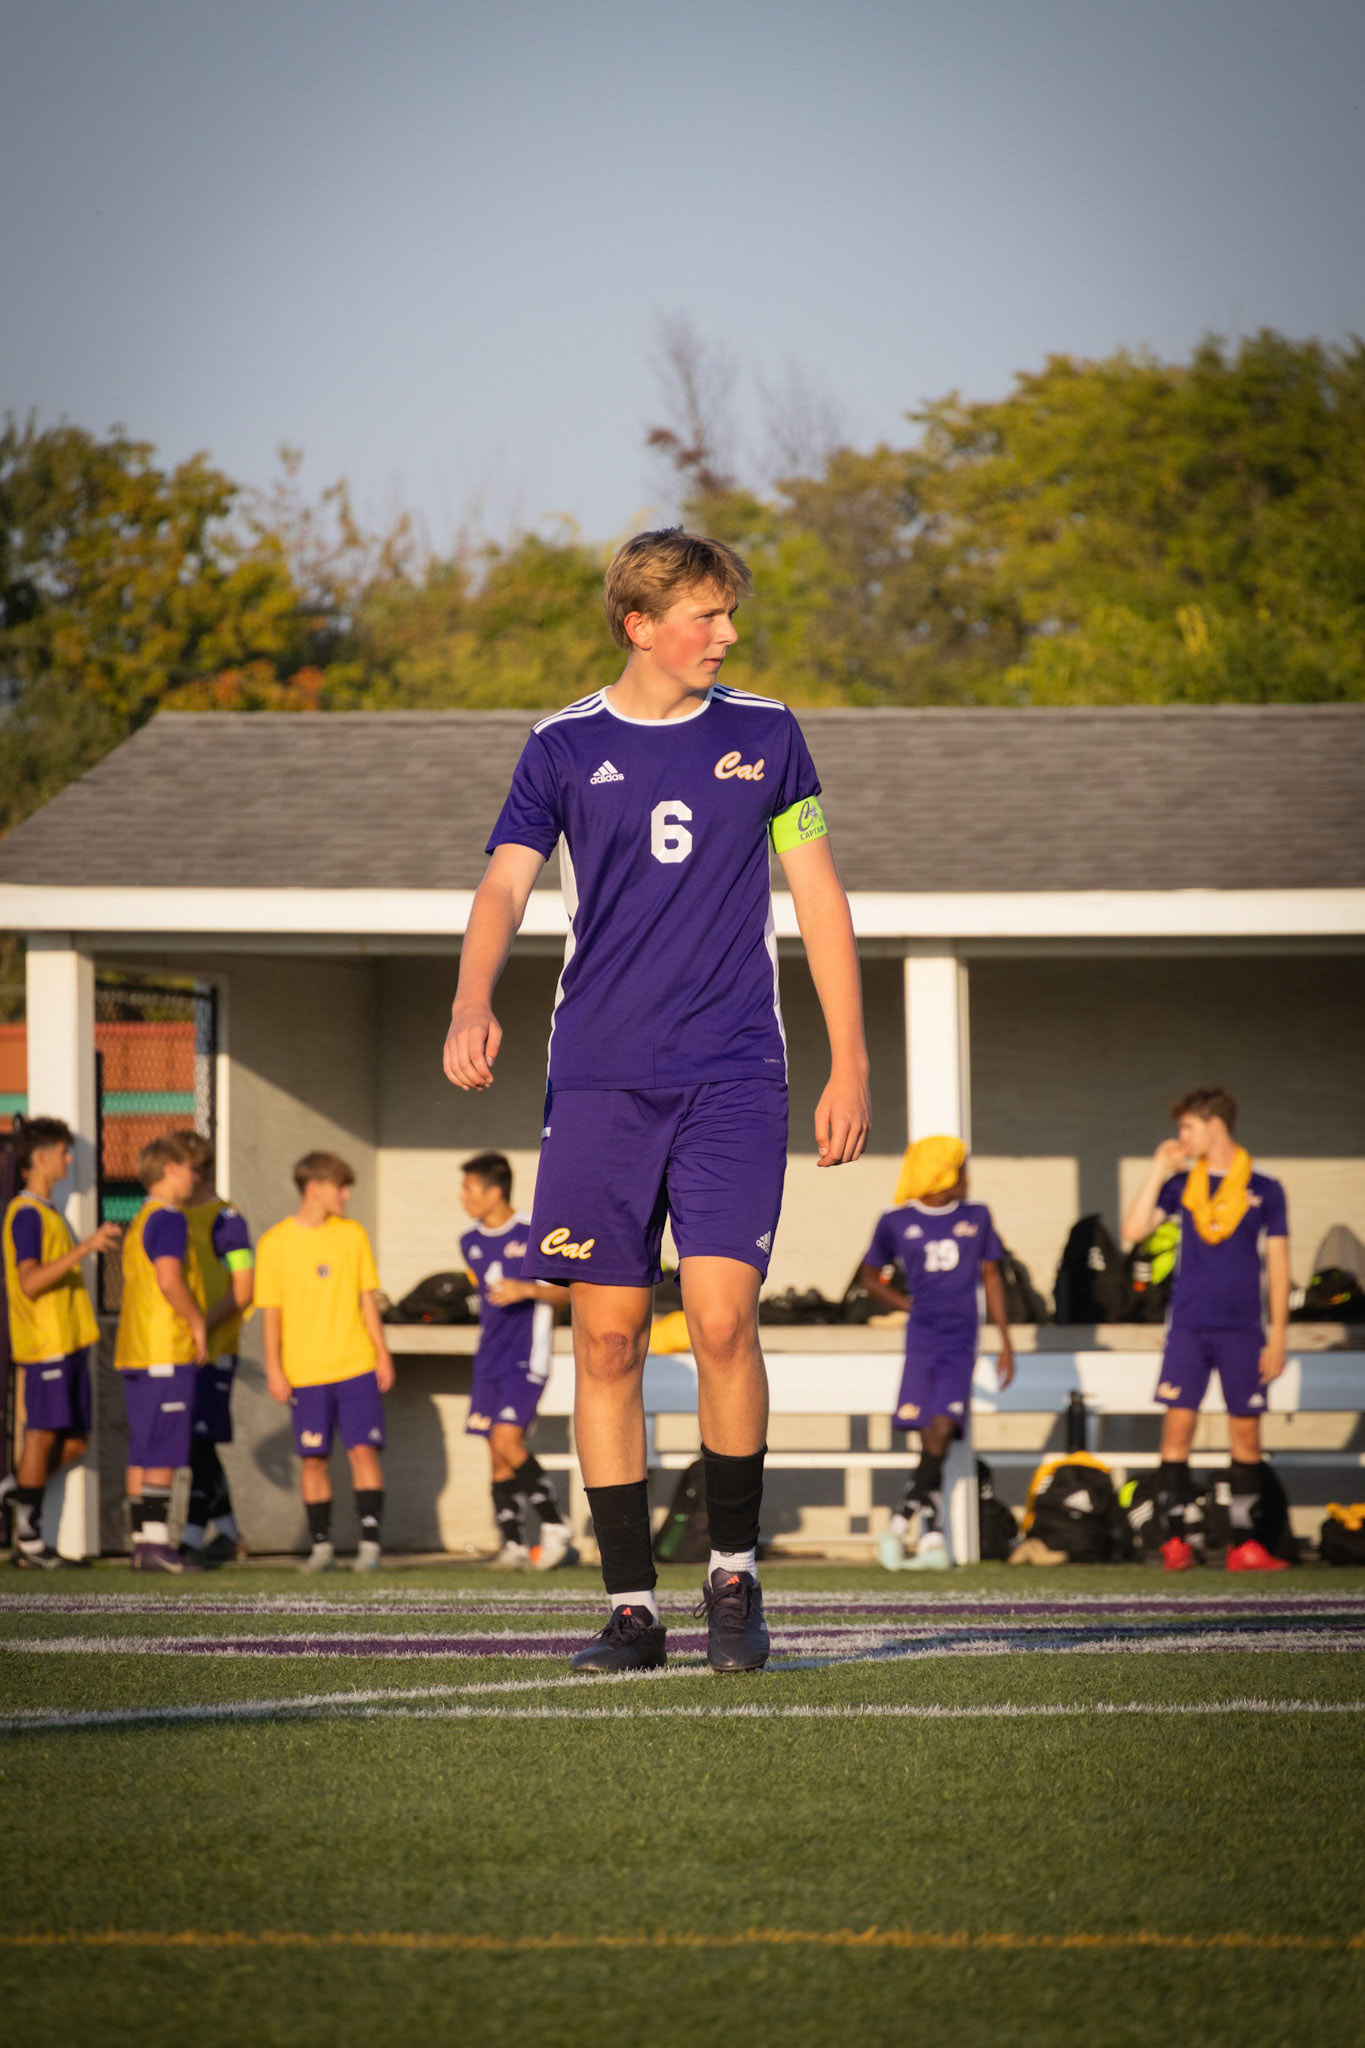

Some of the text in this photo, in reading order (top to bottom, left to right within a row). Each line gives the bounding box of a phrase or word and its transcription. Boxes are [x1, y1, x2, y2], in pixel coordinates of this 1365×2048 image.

[590, 772, 625, 785] adidas
[714, 751, 765, 781] Cal
[651, 800, 692, 864] 6
[540, 1227, 595, 1260] Cal
[924, 1239, 960, 1273] 19
